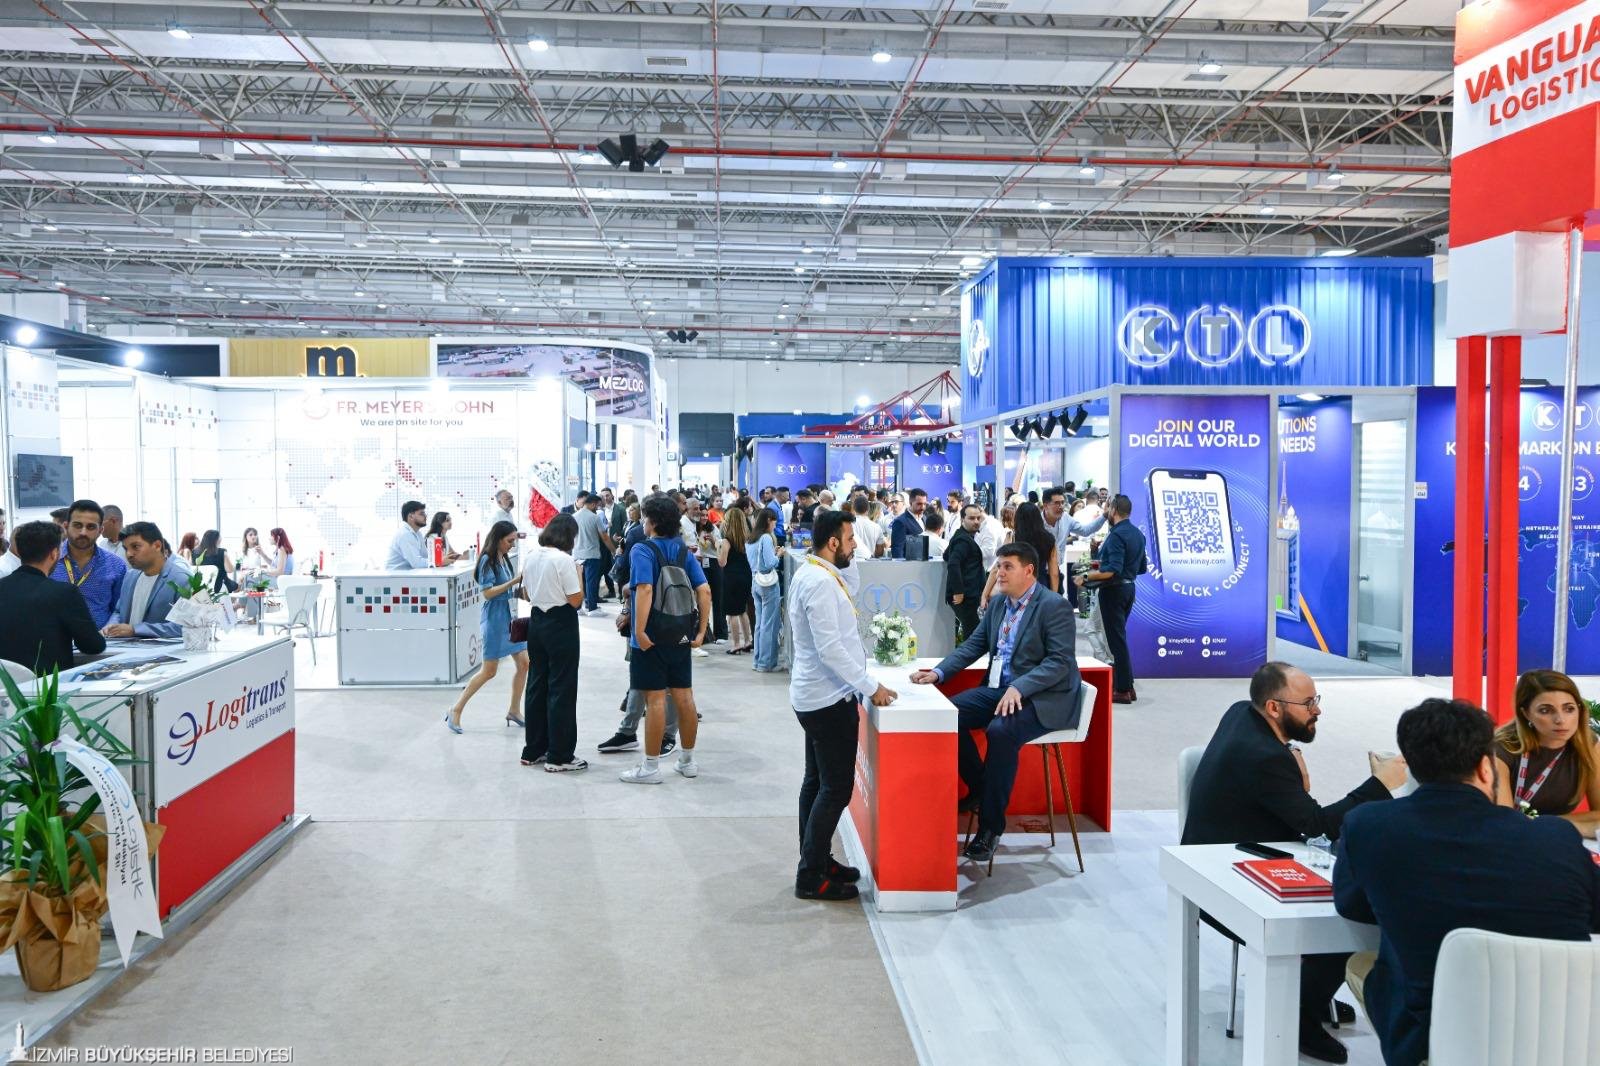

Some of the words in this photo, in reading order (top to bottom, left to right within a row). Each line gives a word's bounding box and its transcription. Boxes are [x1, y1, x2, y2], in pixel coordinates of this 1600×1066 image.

[1465, 14, 1600, 105] VANGUA
[1489, 56, 1600, 126] LOGISTIC
[1131, 316, 1294, 356] KTL
[599, 375, 644, 393] MEDLOG
[366, 401, 424, 414] MEYER
[361, 418, 376, 426] We
[410, 418, 427, 426] site
[429, 418, 442, 426] for
[445, 419, 463, 428] you
[1155, 420, 1194, 433] JOIN
[1198, 420, 1235, 433] OUR
[1279, 416, 1317, 434] UTIONS
[1129, 434, 1193, 448] DIGITAL
[1197, 434, 1261, 448] WORLD
[1280, 436, 1316, 453] NEEDS
[777, 465, 806, 473] KTL
[922, 465, 952, 473] KTL
[1169, 557, 1226, 566] www.kinay.com
[1172, 582, 1212, 597] CLICK
[1222, 542, 1250, 589] CONNECT
[204, 676, 286, 735] Logitrans
[126, 814, 145, 899] Lojistik
